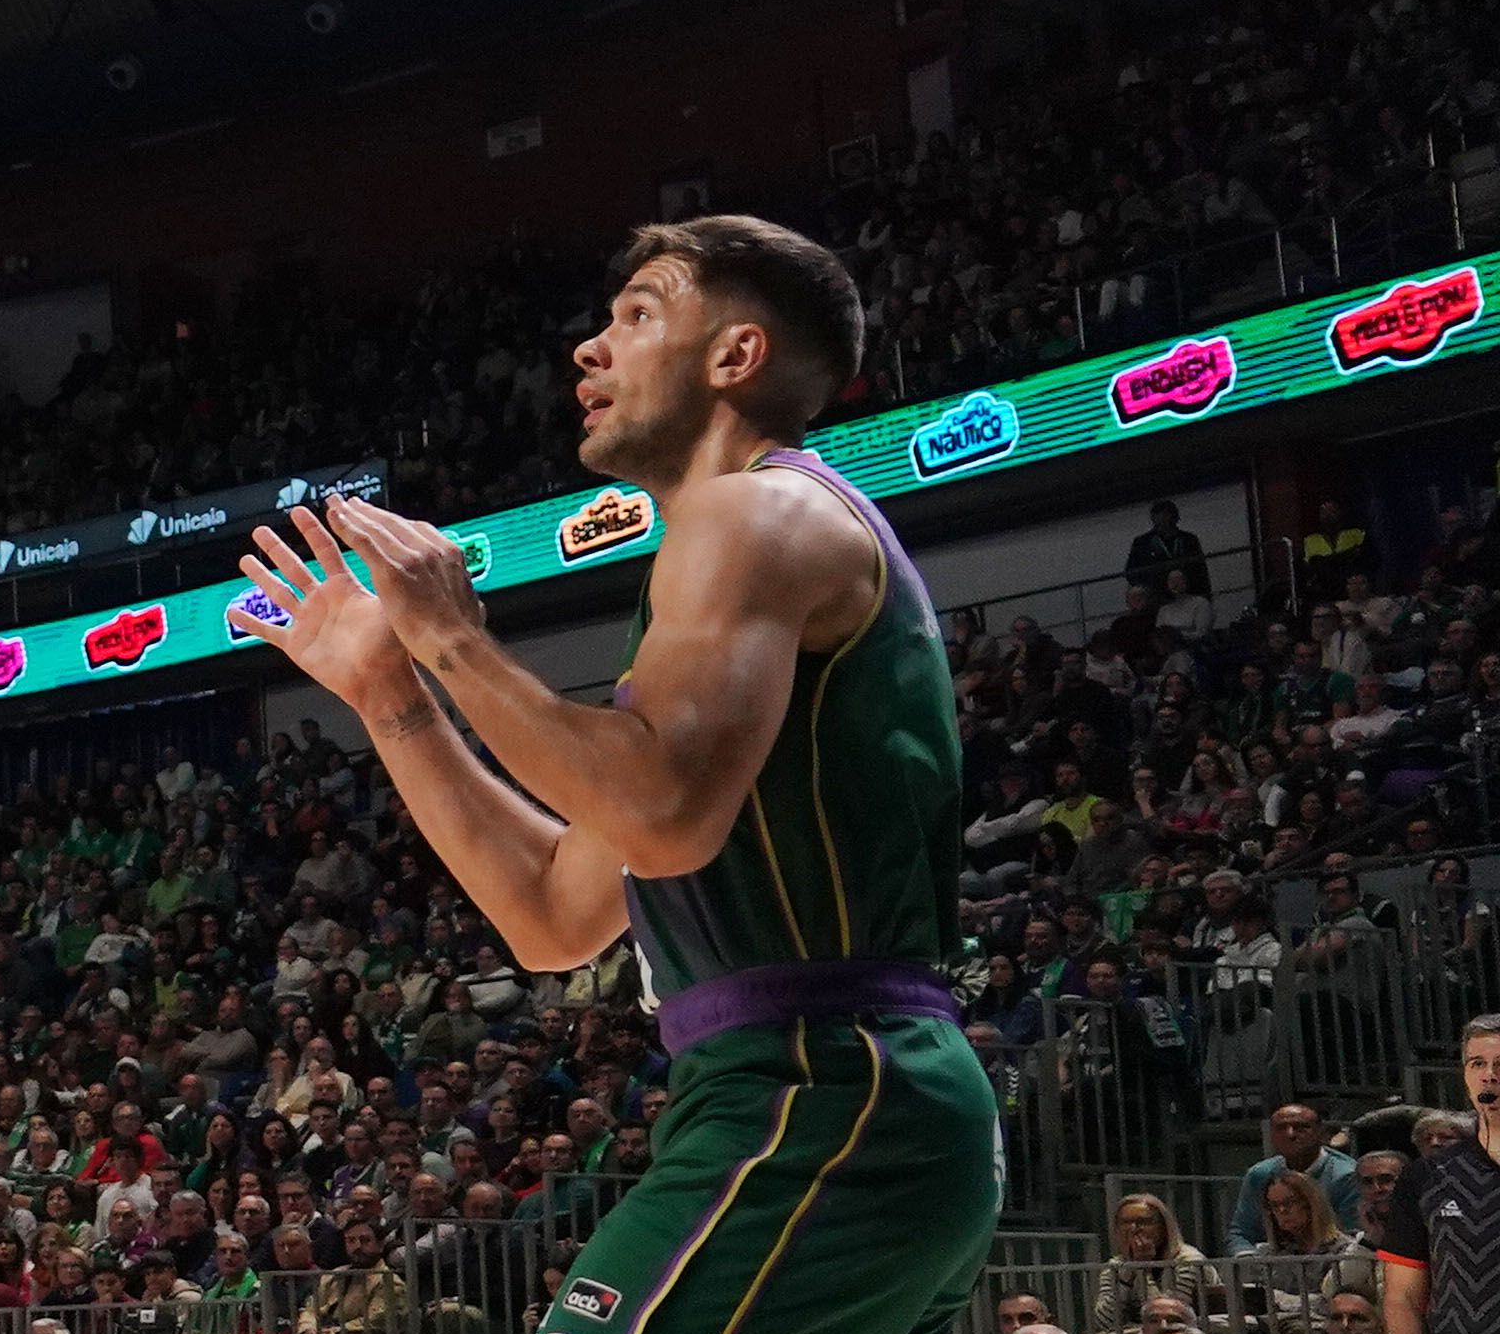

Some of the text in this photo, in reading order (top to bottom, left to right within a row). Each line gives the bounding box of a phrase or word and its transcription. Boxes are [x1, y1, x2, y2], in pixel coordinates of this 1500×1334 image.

[160, 506, 227, 537] Unicaja
[16, 539, 79, 566] Unicaja
[568, 1292, 600, 1313] acb
